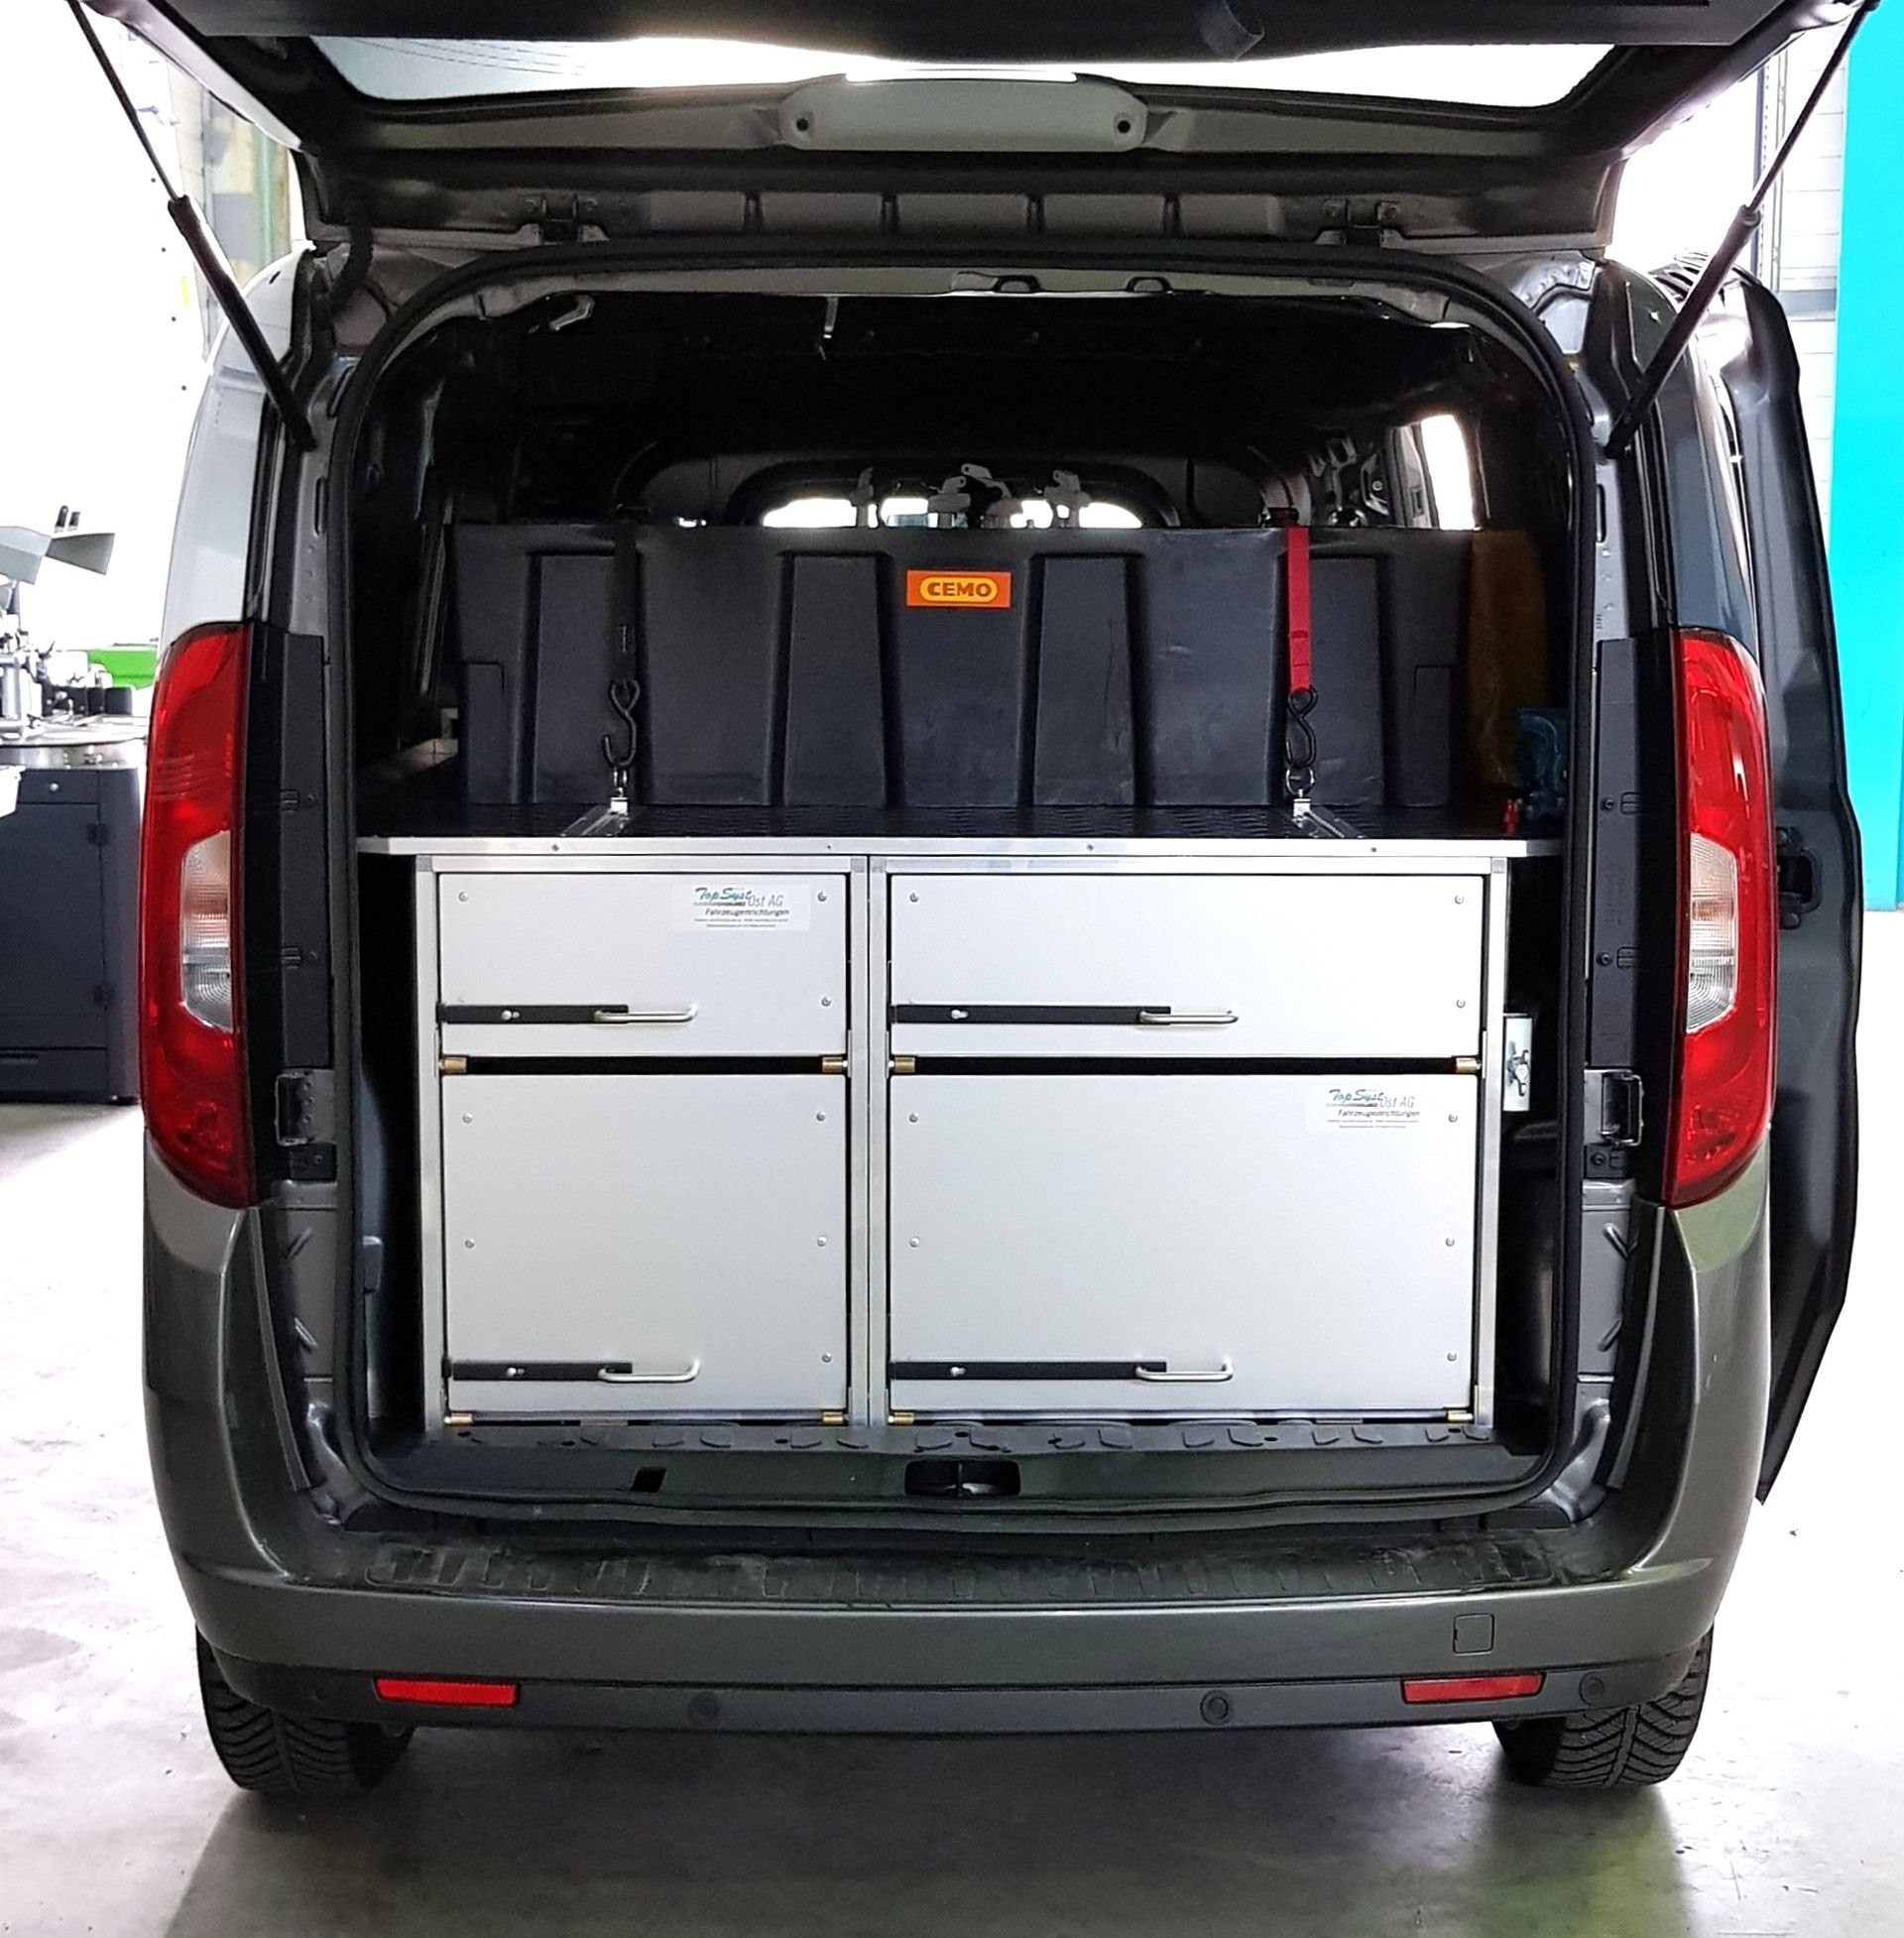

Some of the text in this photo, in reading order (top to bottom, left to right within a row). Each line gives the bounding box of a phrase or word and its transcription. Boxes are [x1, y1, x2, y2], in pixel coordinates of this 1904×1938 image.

[926, 581, 993, 597] CEMO
[768, 895, 784, 908] AG
[1399, 1096, 1415, 1108] AG
